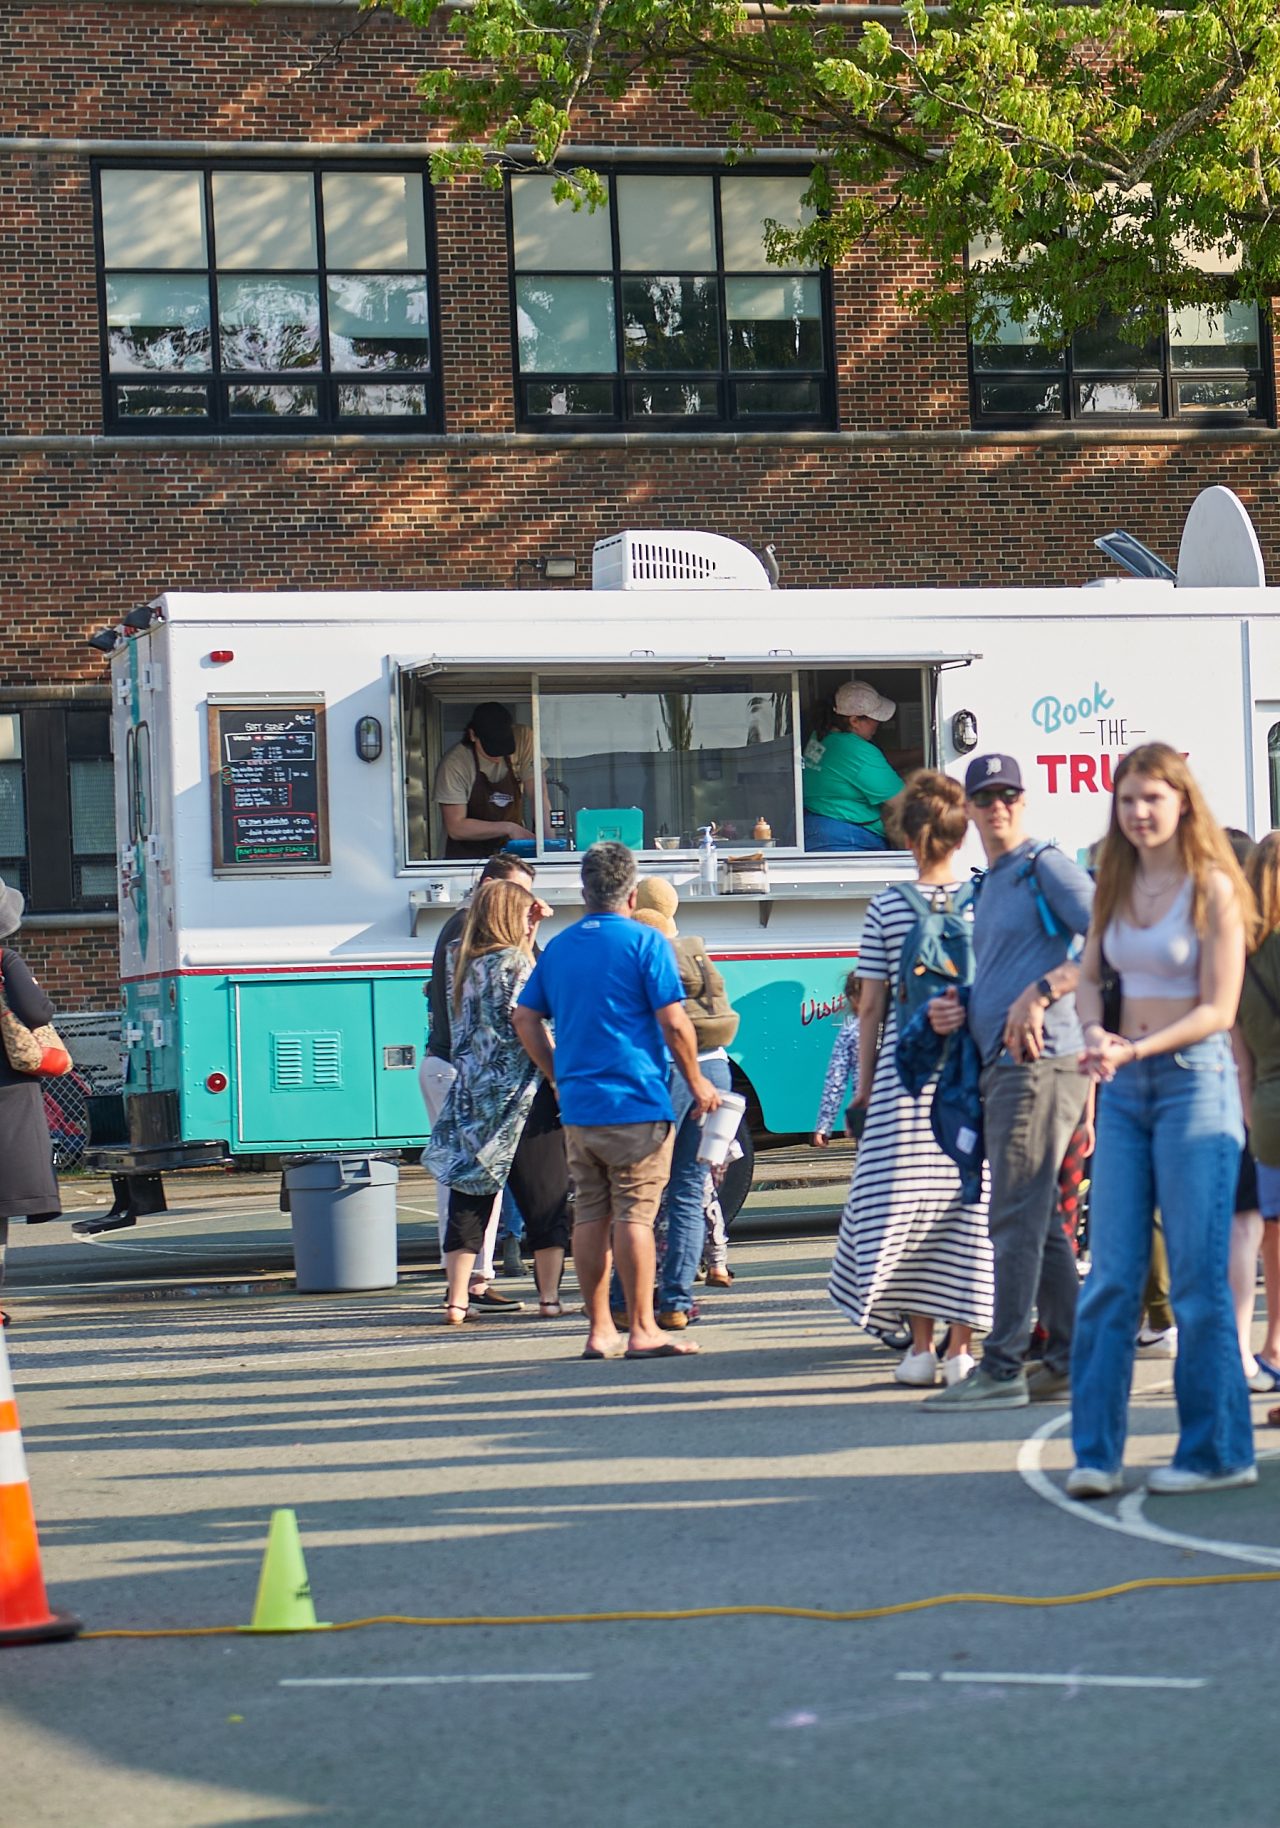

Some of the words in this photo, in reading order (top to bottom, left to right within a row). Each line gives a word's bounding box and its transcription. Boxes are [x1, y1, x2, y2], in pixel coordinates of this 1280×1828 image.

[1031, 681, 1115, 735] Book
[1097, 719, 1129, 746] THE
[801, 993, 848, 1026] Visit
